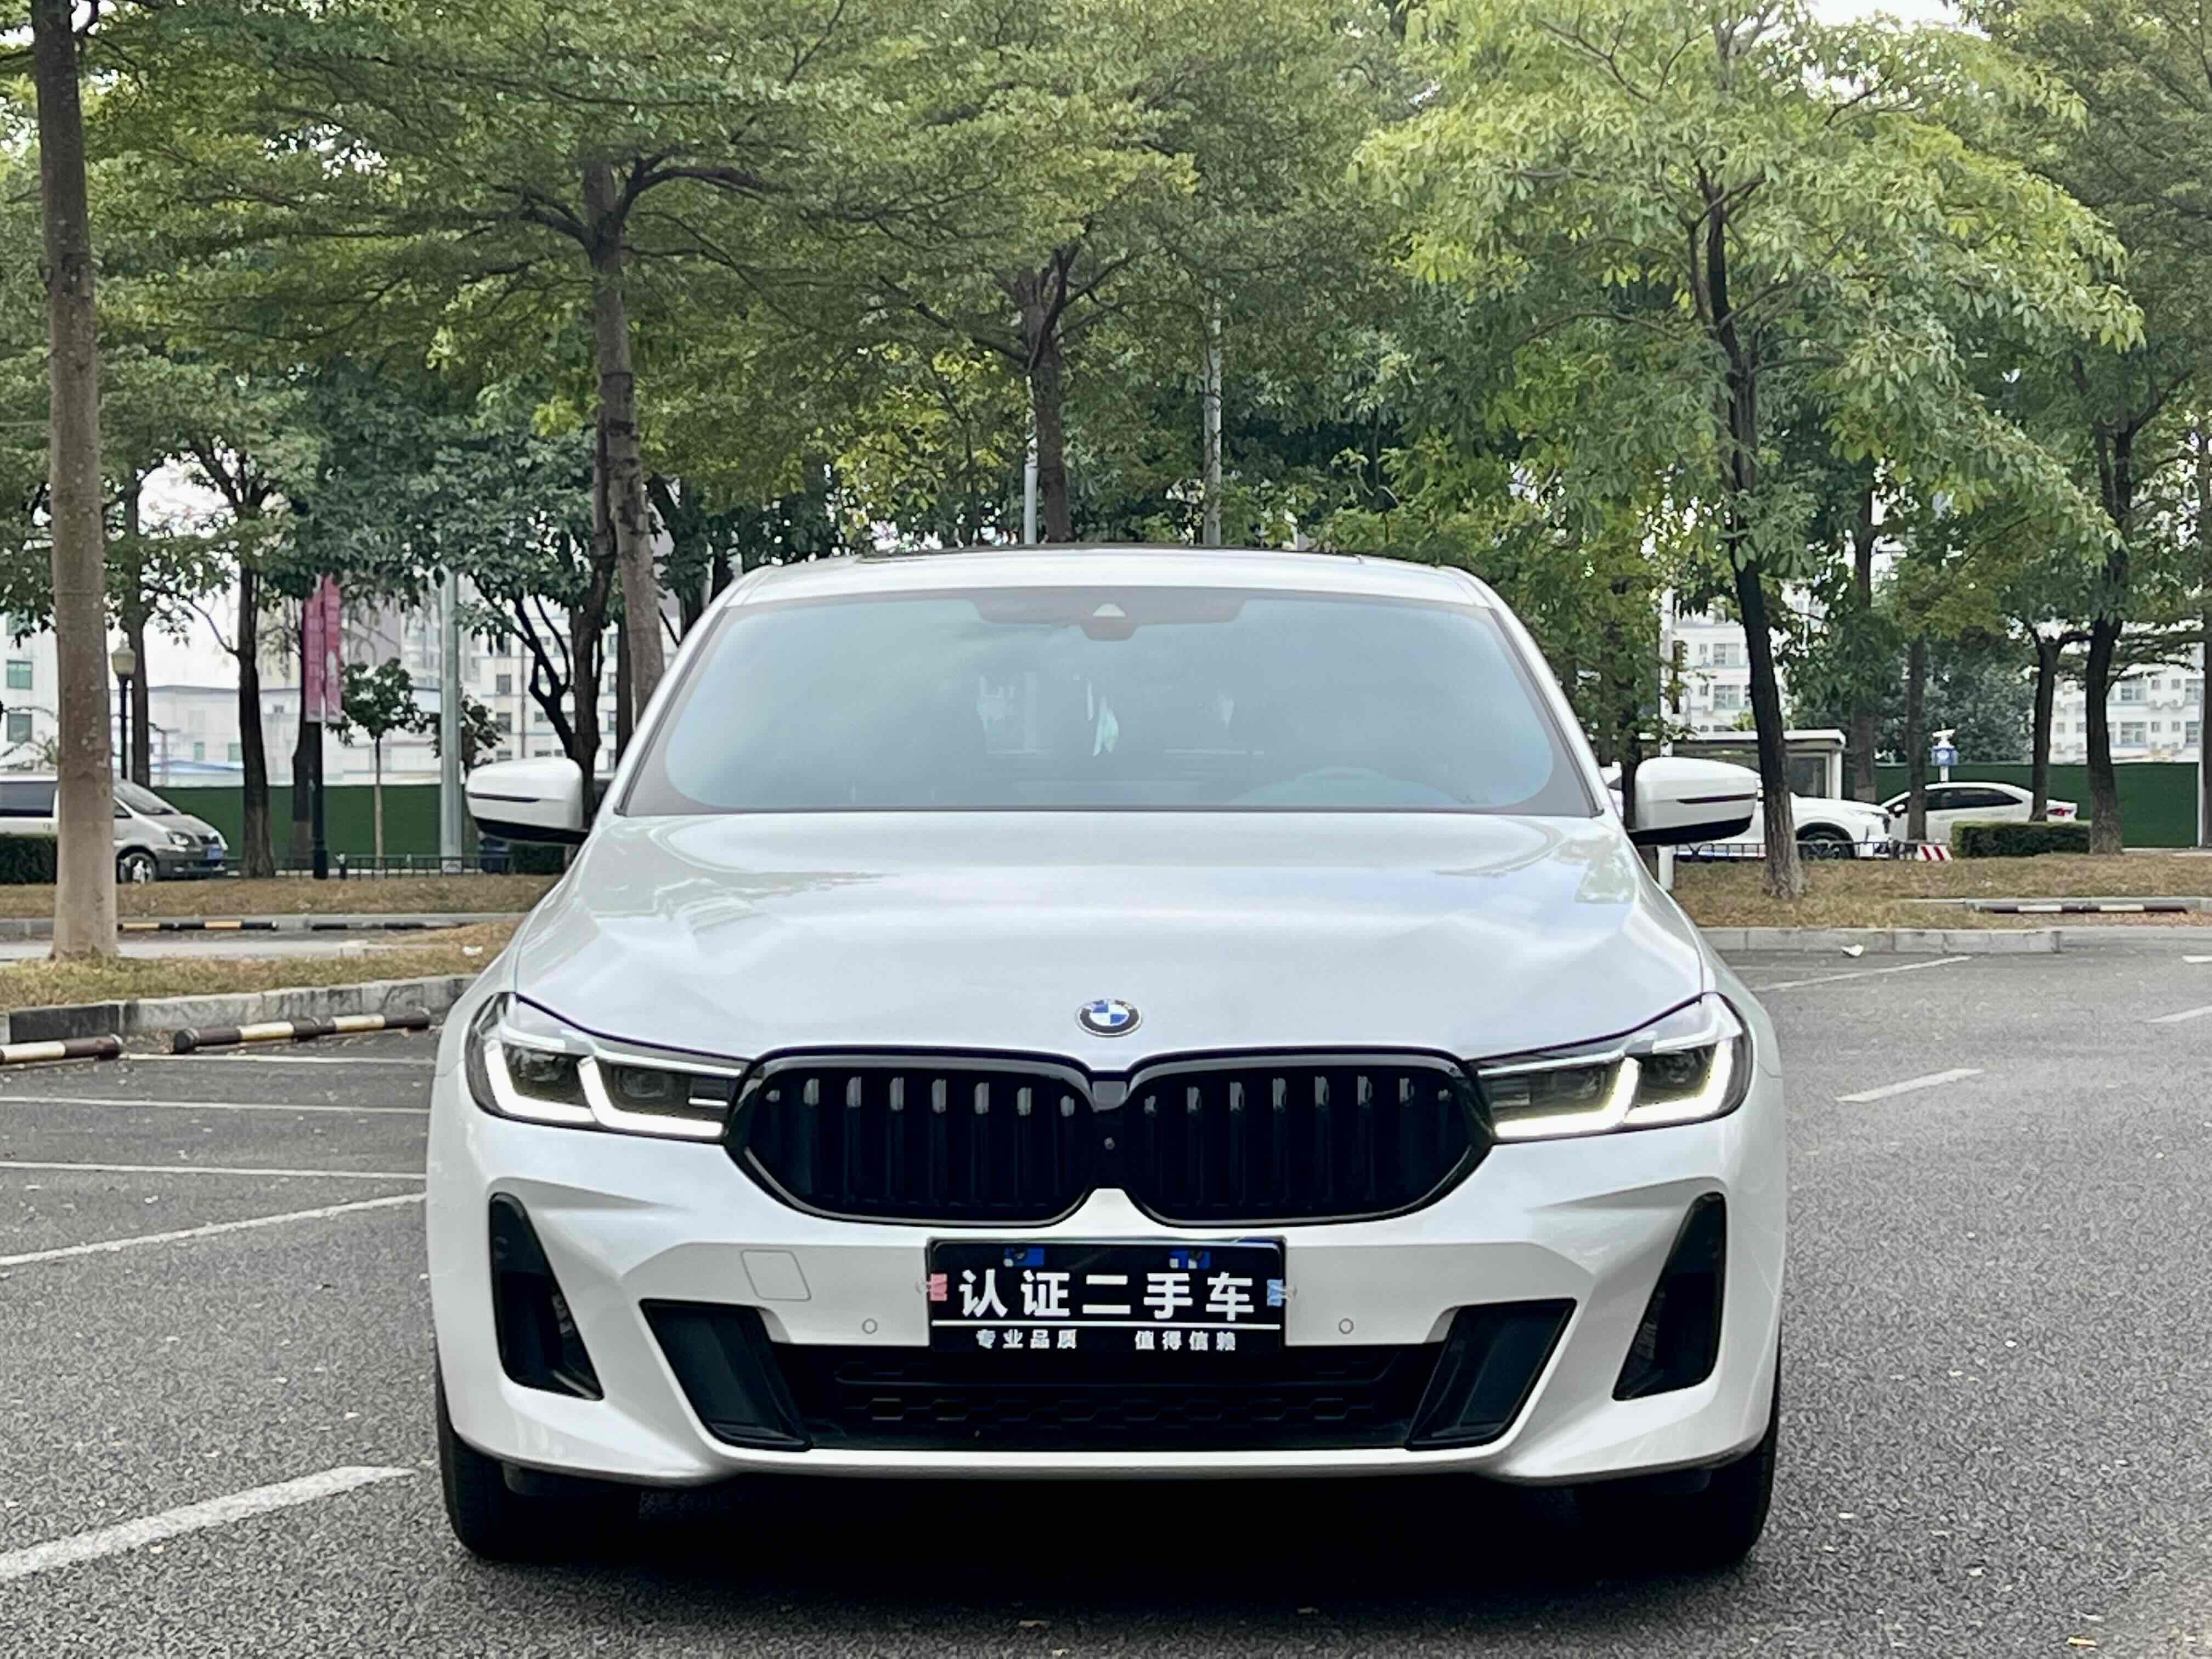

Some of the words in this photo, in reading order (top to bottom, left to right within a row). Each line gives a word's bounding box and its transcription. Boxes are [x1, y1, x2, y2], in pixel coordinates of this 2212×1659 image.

[959, 1269, 1254, 1321] 认证二手车
[976, 1329, 1077, 1349] 专业品质
[1135, 1330, 1235, 1351] 值得信赖
